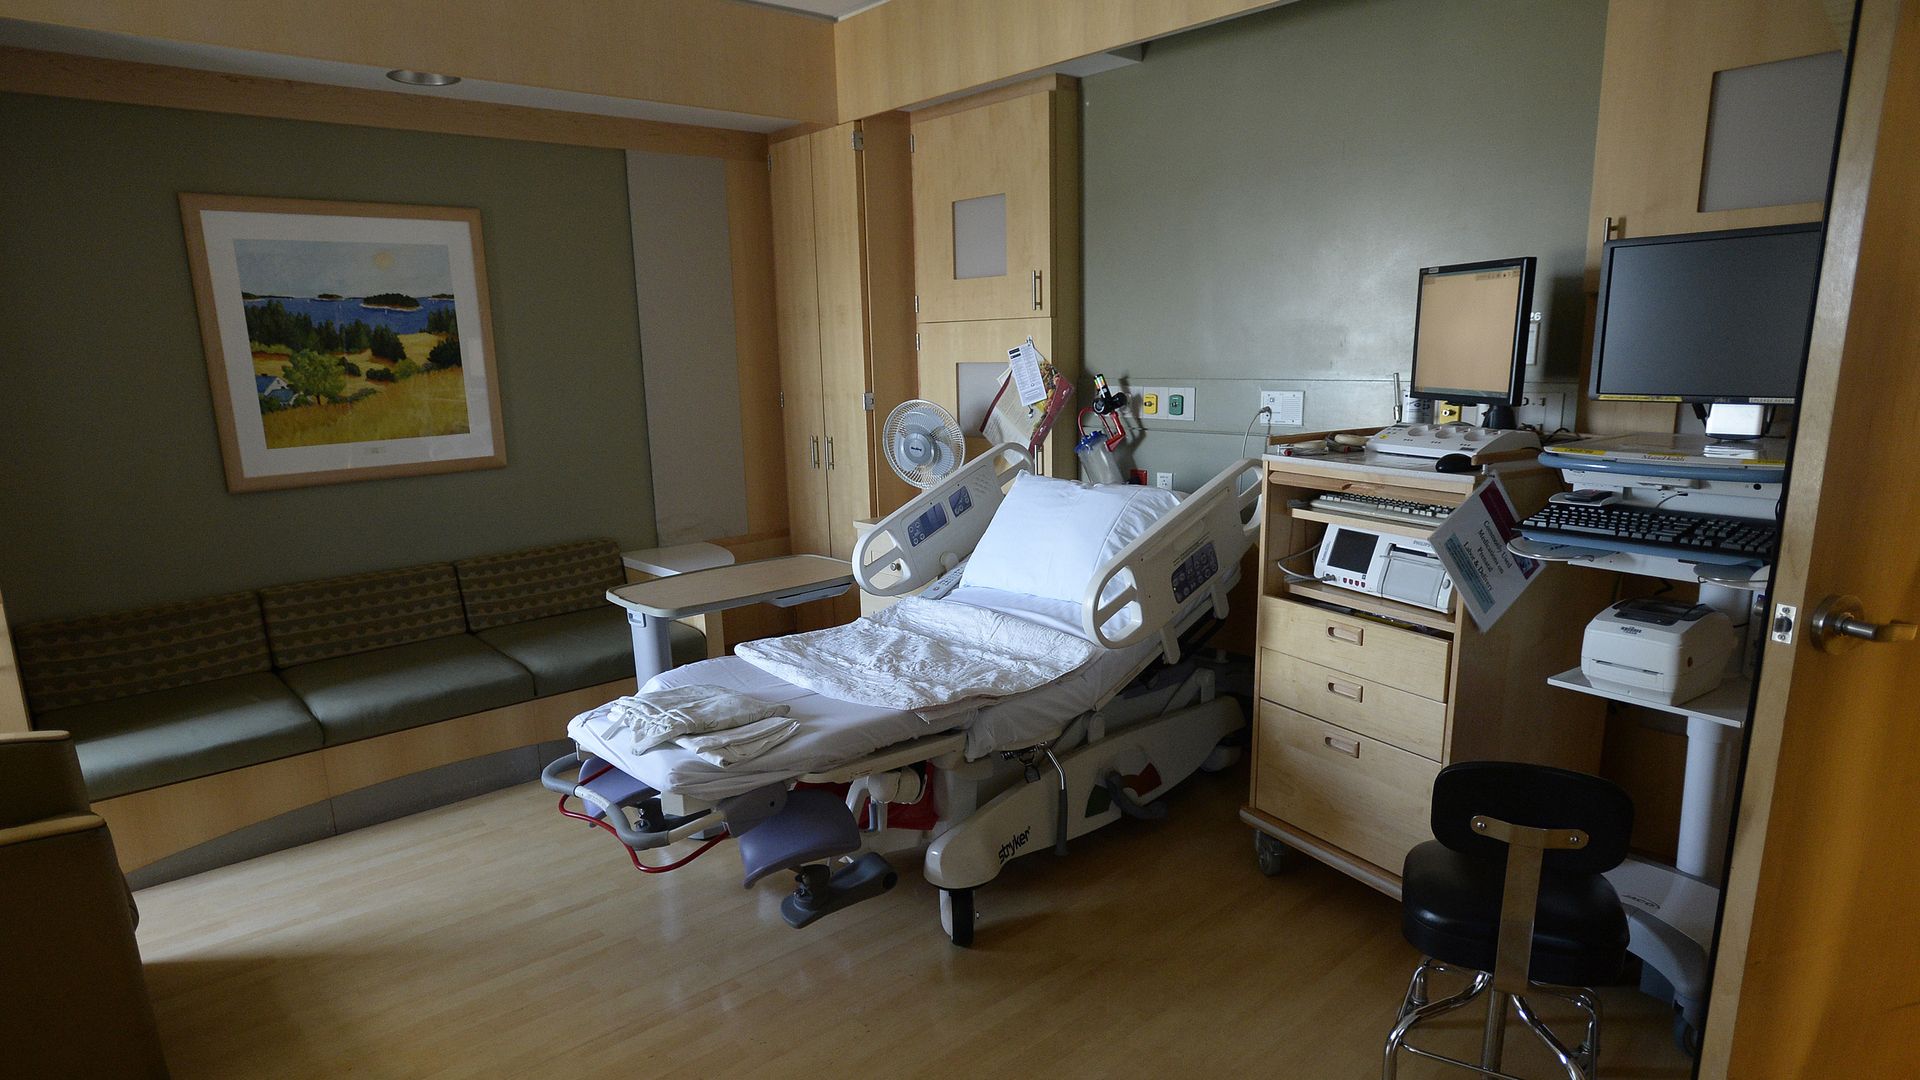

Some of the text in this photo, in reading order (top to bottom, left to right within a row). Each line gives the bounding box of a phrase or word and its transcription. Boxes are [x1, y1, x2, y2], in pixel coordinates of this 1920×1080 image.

[1477, 546, 1493, 573] Prenatal
[1478, 529, 1500, 566] Medications
[1484, 520, 1512, 569] Commonly Used
[1463, 541, 1477, 561] Labor
[1479, 566, 1493, 591] Delivery
[998, 829, 1030, 864] stryker
